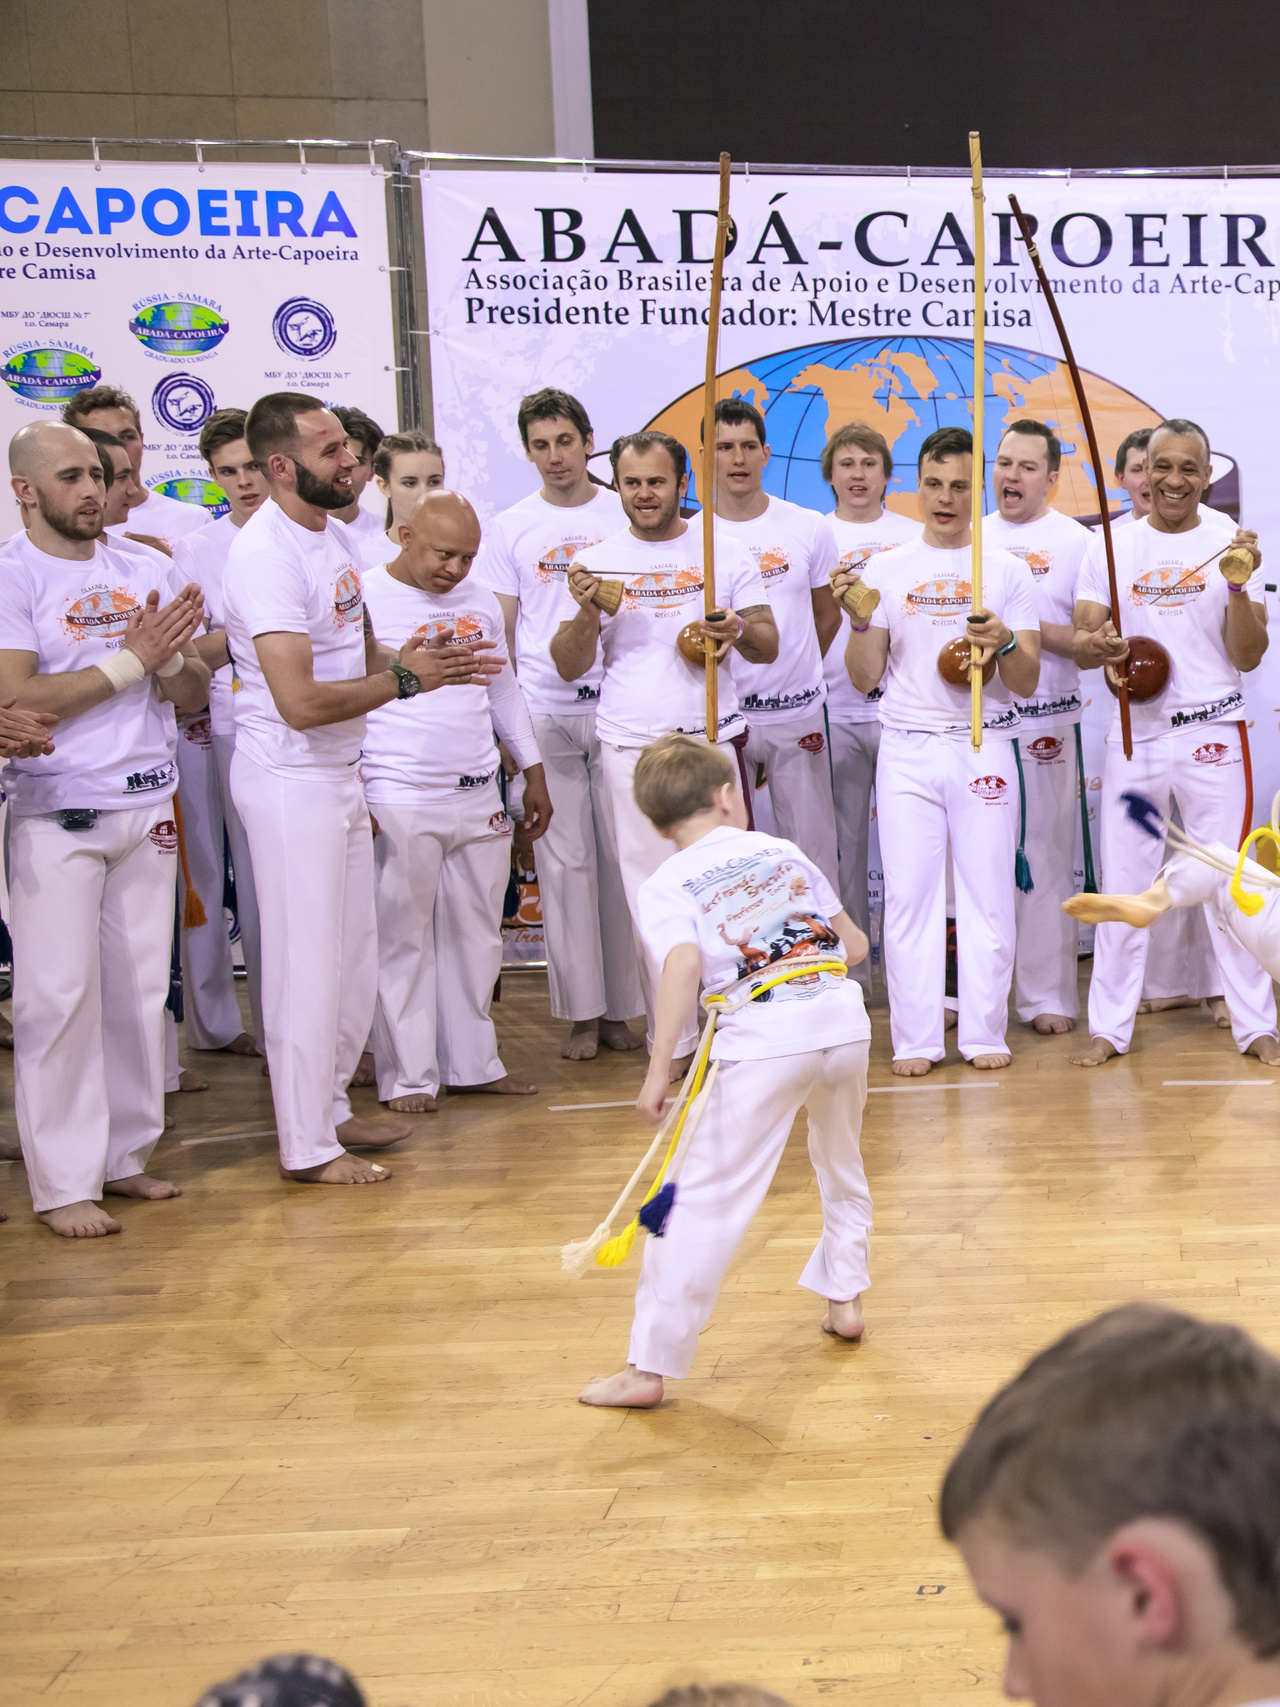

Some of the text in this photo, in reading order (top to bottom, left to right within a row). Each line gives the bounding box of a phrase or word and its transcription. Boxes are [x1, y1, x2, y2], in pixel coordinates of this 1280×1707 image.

[0, 185, 358, 238] CAPOEIRA
[20, 248, 29, 258] e
[35, 242, 199, 259] Desenvolvimento
[205, 246, 226, 260] da
[233, 246, 359, 265] Arte-Capoeira
[22, 264, 97, 280] Camisa
[464, 268, 608, 296] Associação
[752, 270, 781, 292] de
[791, 270, 869, 299] Apoio
[877, 278, 889, 292] e
[1132, 272, 1161, 294] da
[465, 297, 630, 326] Presidente
[808, 300, 911, 327] Mestre
